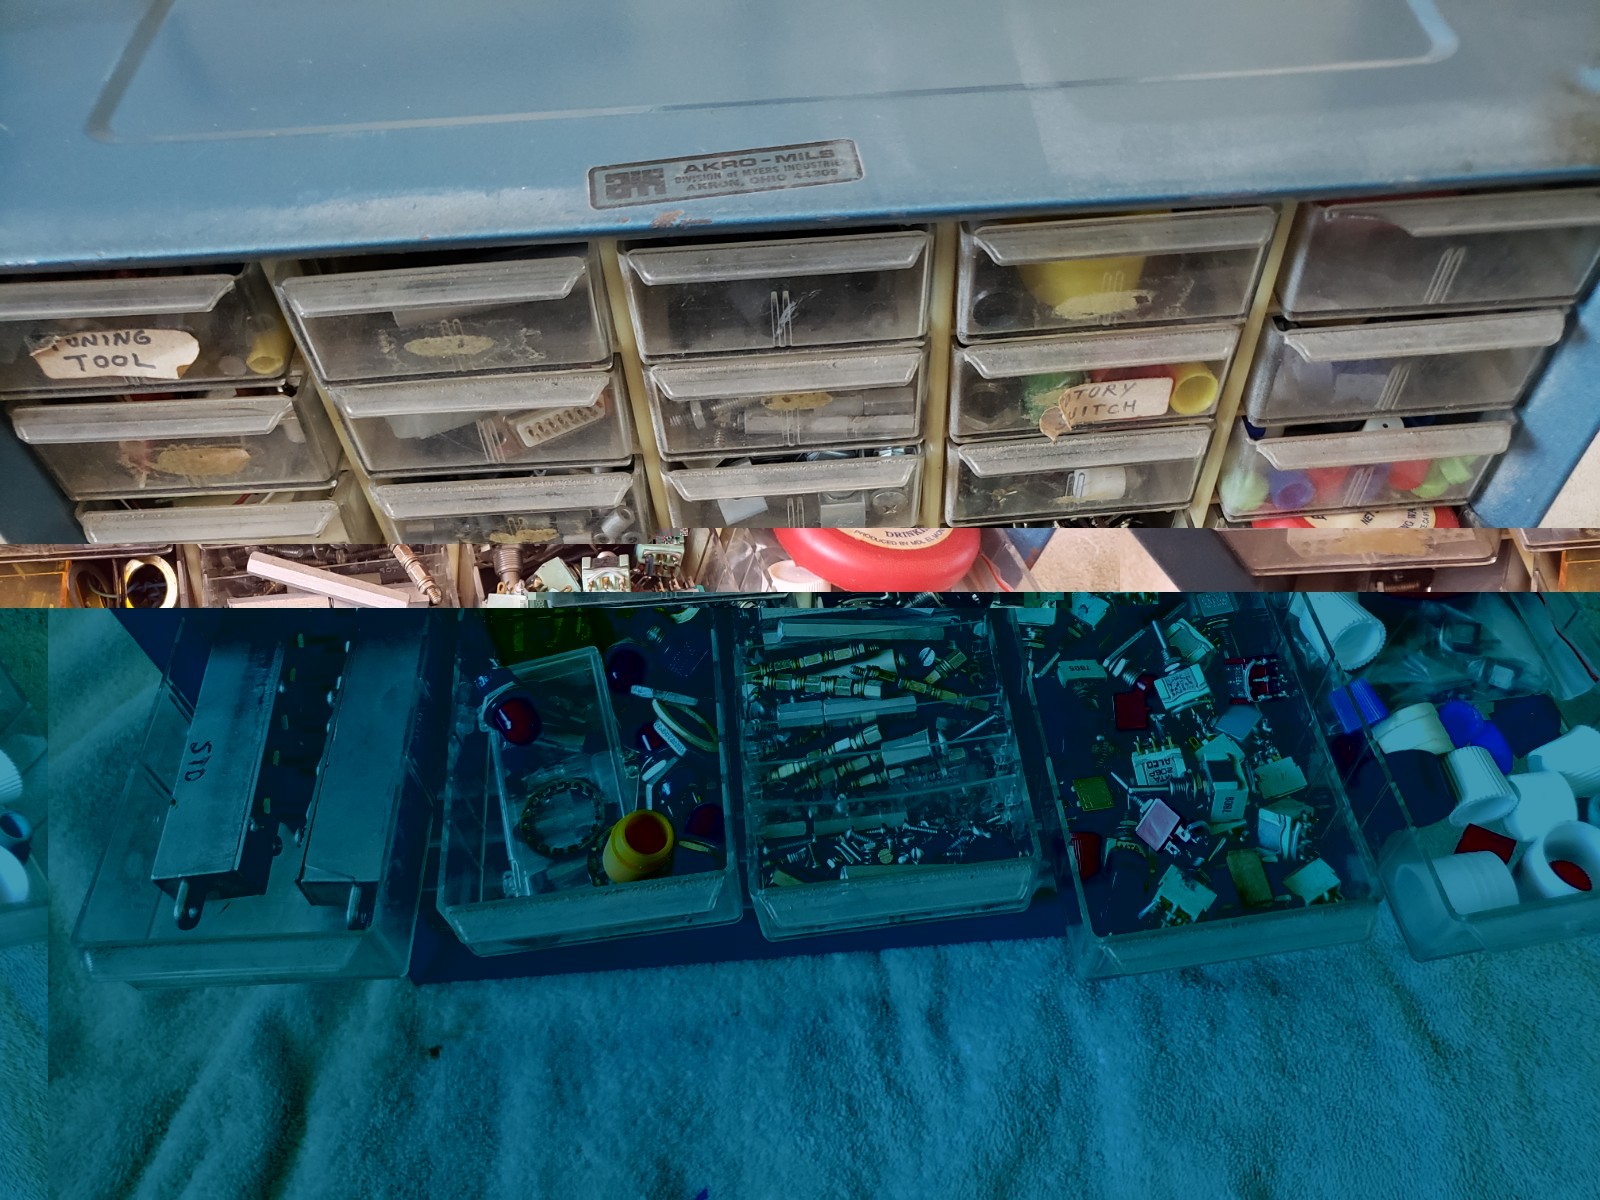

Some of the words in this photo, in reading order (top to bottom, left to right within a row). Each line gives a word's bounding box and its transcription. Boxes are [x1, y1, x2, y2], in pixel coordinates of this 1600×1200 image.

[674, 172, 722, 184] DIVISION
[742, 165, 780, 176] MYERS
[686, 179, 745, 192] AKRON,
[749, 174, 787, 185] OHIO
[63, 352, 157, 372] TOOL
[853, 529, 898, 546] PRODUCED
[1146, 757, 1171, 769] ALCO
